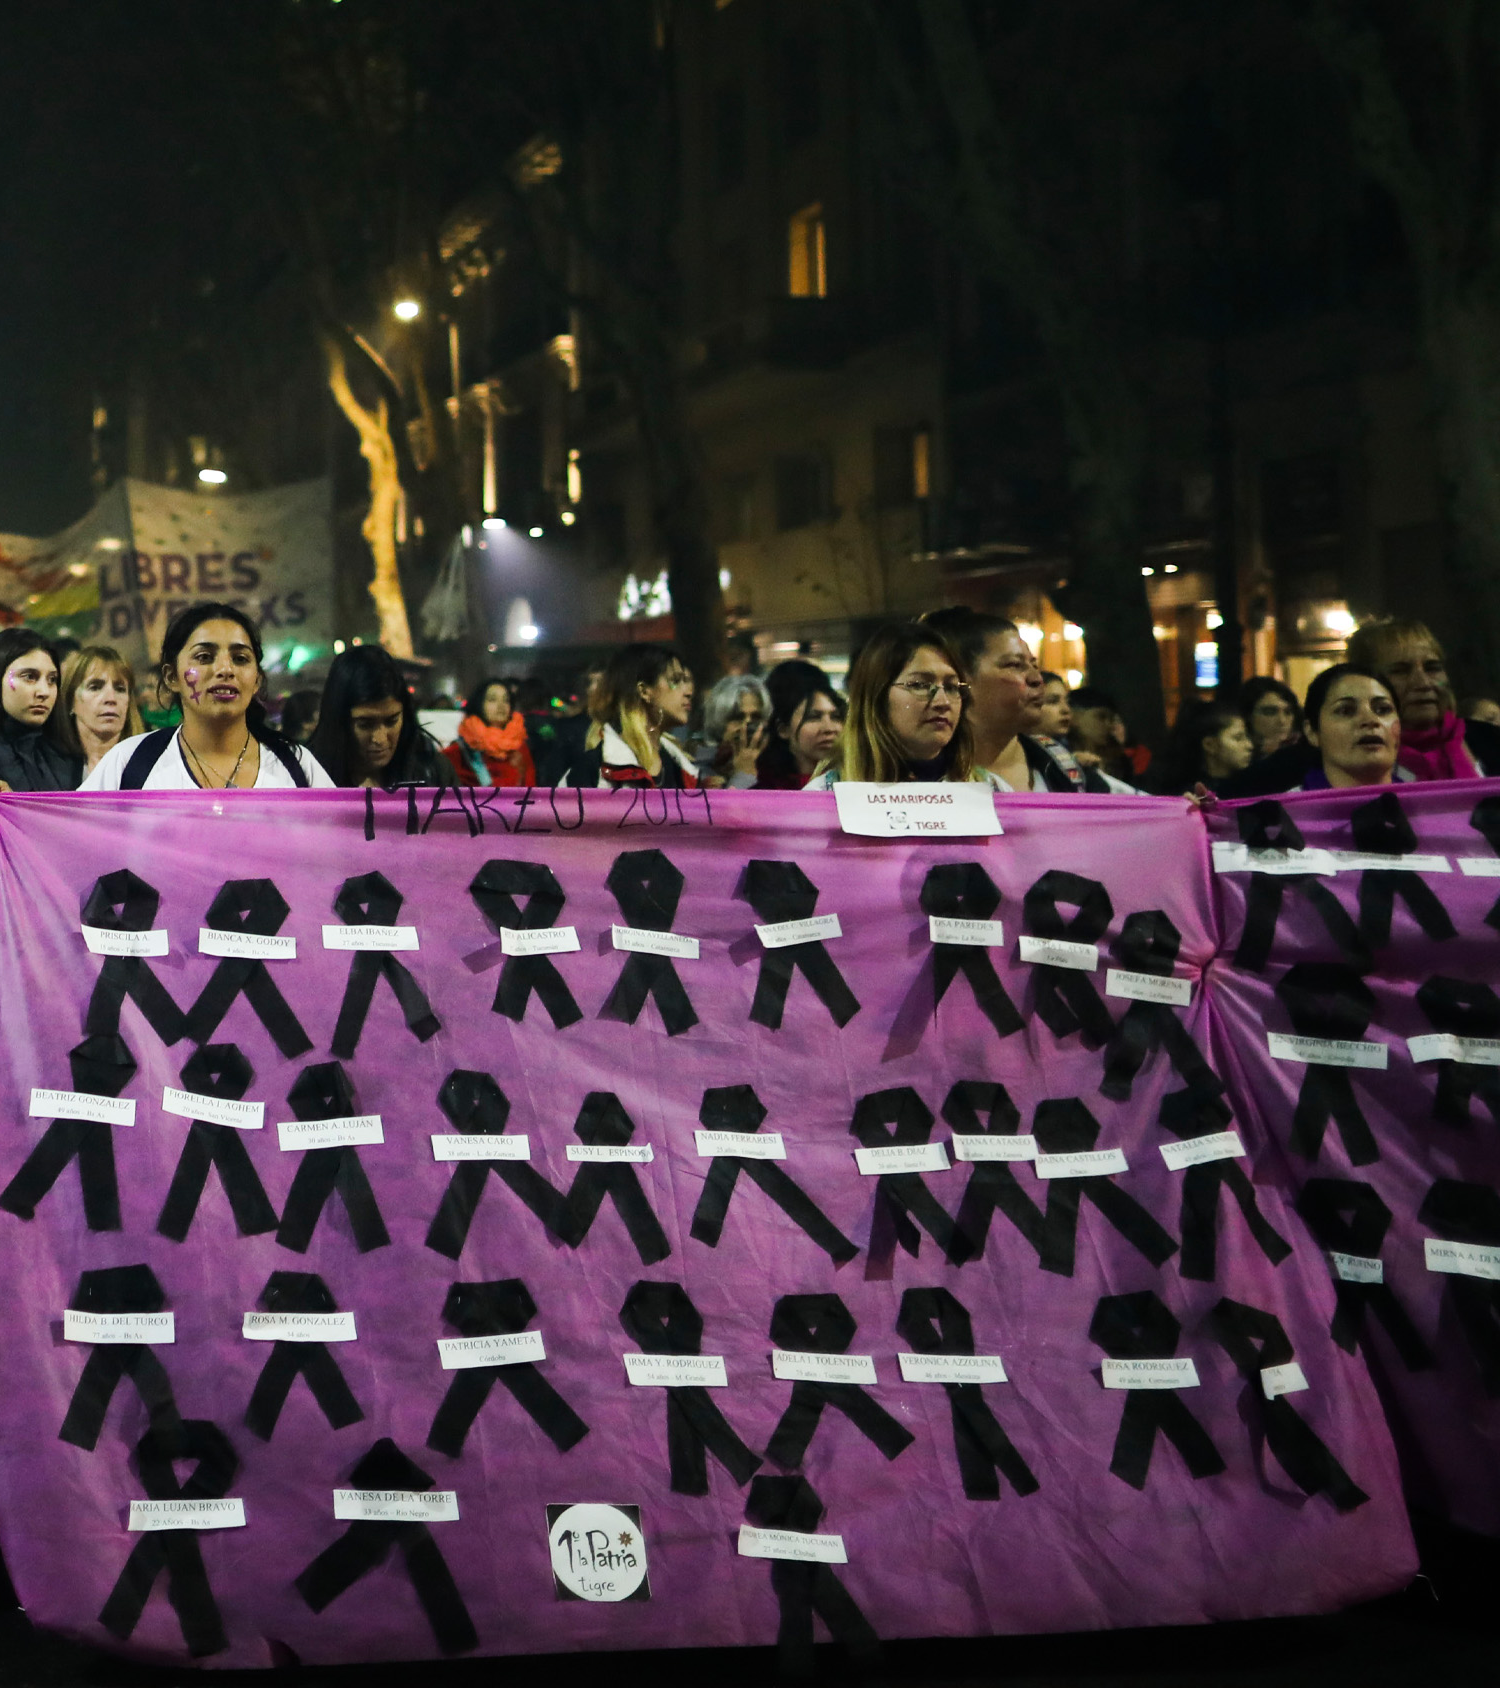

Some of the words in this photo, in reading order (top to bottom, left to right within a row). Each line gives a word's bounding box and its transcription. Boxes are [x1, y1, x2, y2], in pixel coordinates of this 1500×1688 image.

[99, 551, 261, 601] LIBRES
[867, 794, 887, 804] LAS
[889, 794, 954, 805] MARIPOSAS
[913, 821, 947, 830] TIGRE
[100, 931, 138, 941] PRISCILA
[339, 928, 364, 936] ELBA
[366, 927, 399, 937] IBAÑEZ
[516, 931, 566, 941] ALICASTRO
[207, 932, 244, 943] BIANCA
[255, 936, 290, 948] GODOY
[35, 1090, 76, 1103] BEATRIZ
[78, 1096, 131, 1111] GONZALEZ
[168, 1089, 215, 1107] FIORELLA
[223, 1101, 259, 1113] AGHEM
[286, 1122, 329, 1134] CARMEN
[446, 1137, 485, 1145] VANESA
[486, 1137, 514, 1146] CARO
[700, 1133, 729, 1142] NADIA
[571, 1147, 595, 1156] SUSY
[907, 1147, 928, 1156] DIAZ
[1430, 1247, 1464, 1259] MIRNA
[68, 1314, 98, 1326] HILDA
[111, 1317, 131, 1326] DEL
[132, 1316, 168, 1326] TURCO
[250, 1315, 277, 1324] ROSA
[292, 1316, 345, 1326] GONZALEZ
[444, 1338, 492, 1352] PATRICIA
[493, 1335, 536, 1347] YAMETA
[479, 1354, 506, 1363] Córdoba
[628, 1357, 654, 1367] IRMA
[666, 1358, 721, 1369] RODRIGUEZ
[776, 1352, 807, 1363] ADELA
[815, 1356, 868, 1368] TOLENTINO
[903, 1356, 950, 1366] VERONICA
[951, 1358, 998, 1368] AZZOLINA
[1132, 1361, 1189, 1371] RODRIGUEZ
[340, 1492, 382, 1502] VANESA
[419, 1493, 452, 1504] TORRE
[199, 1503, 236, 1512] BRAVO
[409, 1509, 430, 1518] Negro
[801, 1536, 839, 1548] TUCUMAN
[585, 1529, 638, 1572] Patria
[577, 1576, 616, 1597] tigre
